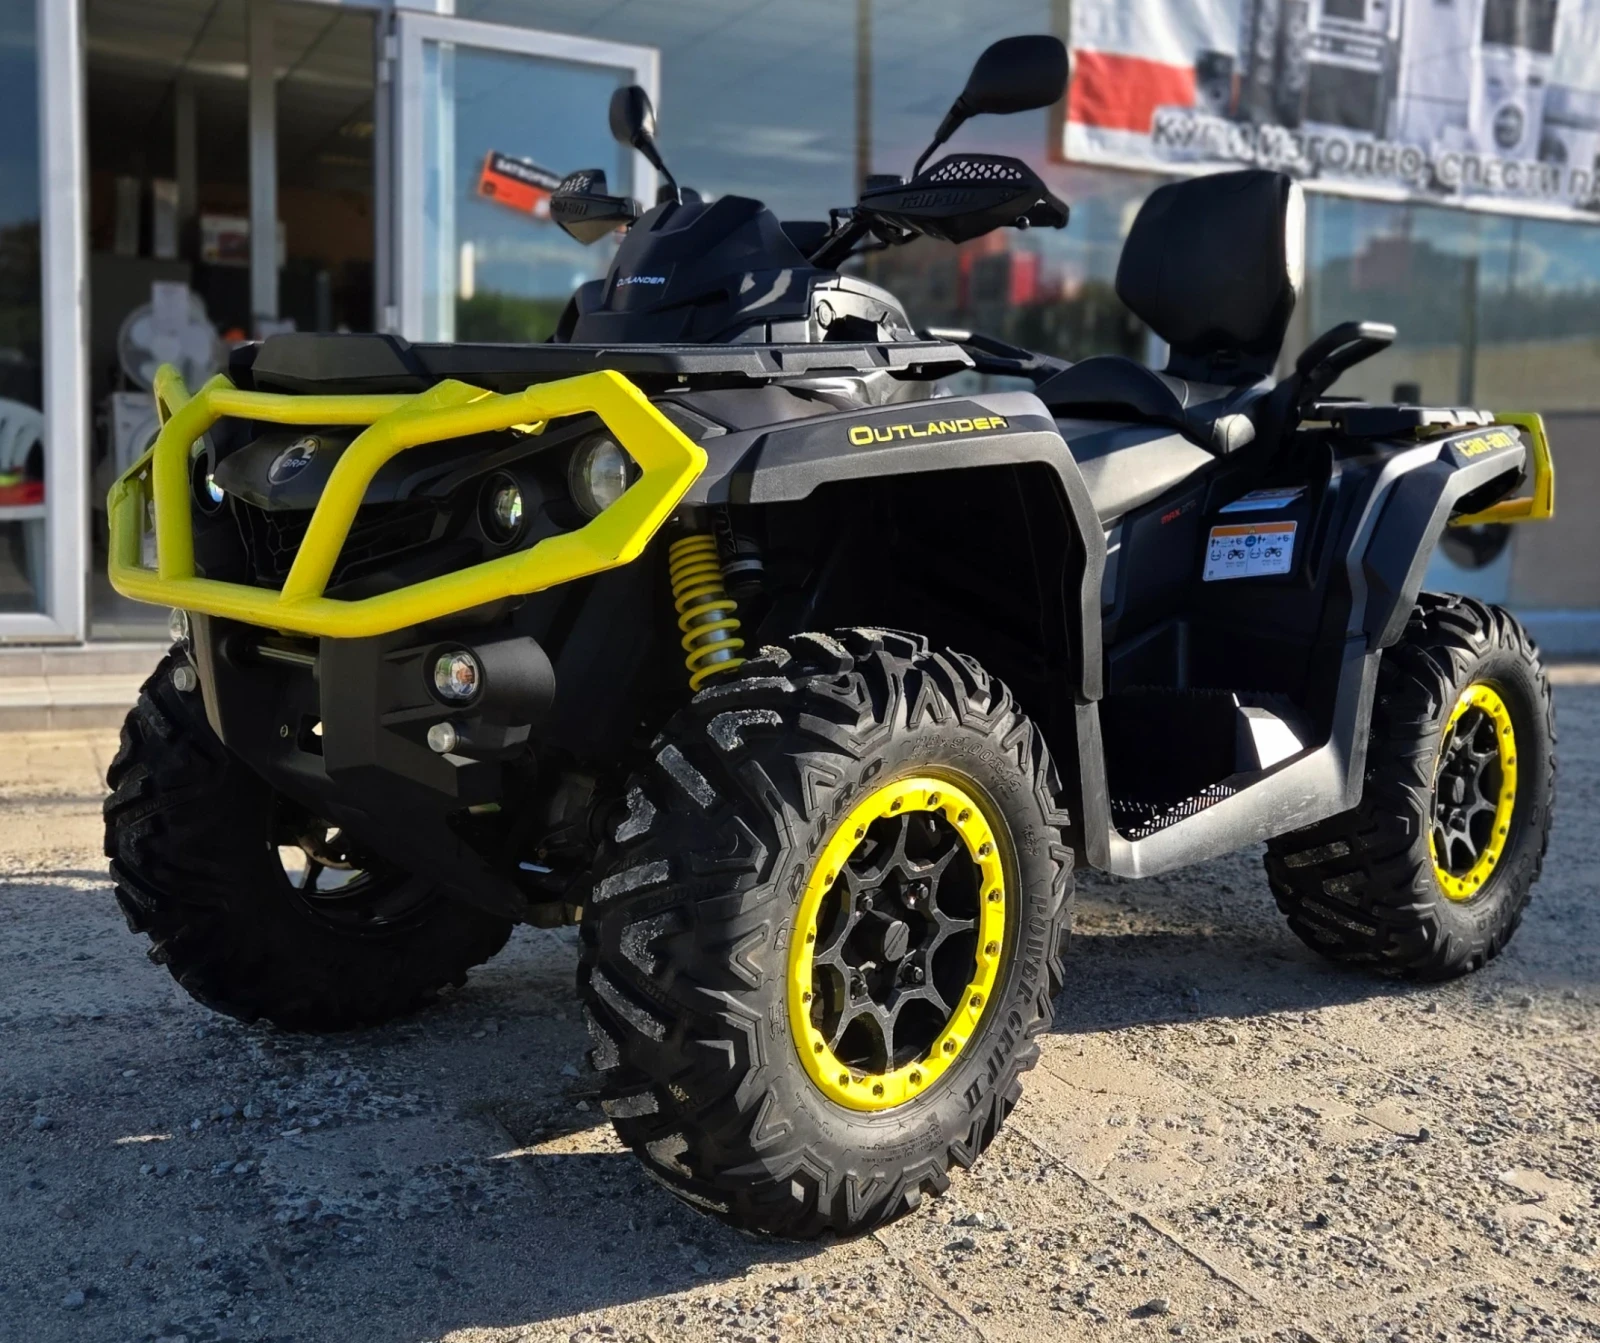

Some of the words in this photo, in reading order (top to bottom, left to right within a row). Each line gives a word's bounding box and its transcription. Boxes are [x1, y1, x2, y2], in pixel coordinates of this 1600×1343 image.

[850, 416, 1008, 446] OUTLANDER
[283, 458, 307, 468] BRP
[1015, 895, 1048, 1006] POWER
[986, 1009, 1023, 1087] GRIP
